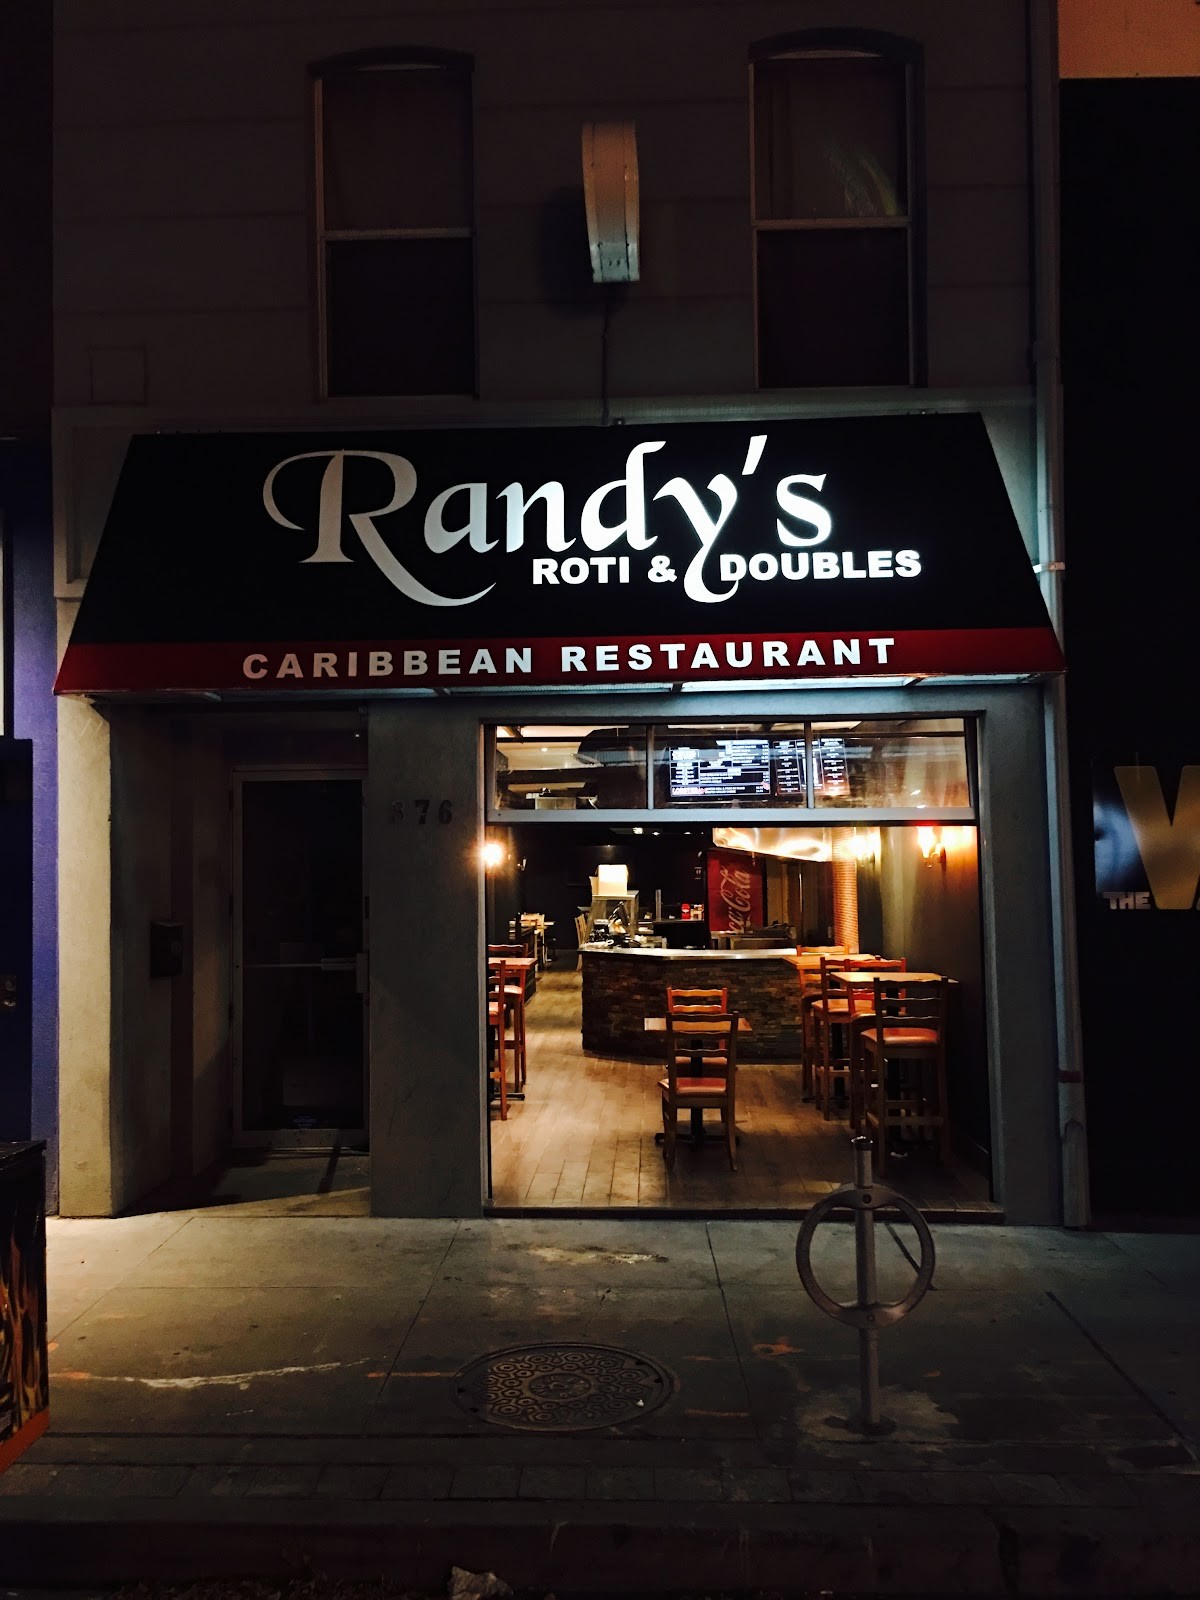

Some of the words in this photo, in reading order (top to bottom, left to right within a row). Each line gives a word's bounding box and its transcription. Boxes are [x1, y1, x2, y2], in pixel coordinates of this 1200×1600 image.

[262, 434, 834, 607] Randy's
[532, 556, 630, 586] ROTI
[648, 554, 678, 584] &
[719, 549, 922, 584] DOUBLES
[242, 647, 533, 680] CARIBBEAN
[561, 637, 896, 674] RESTAURANT
[1102, 890, 1151, 910] THE
